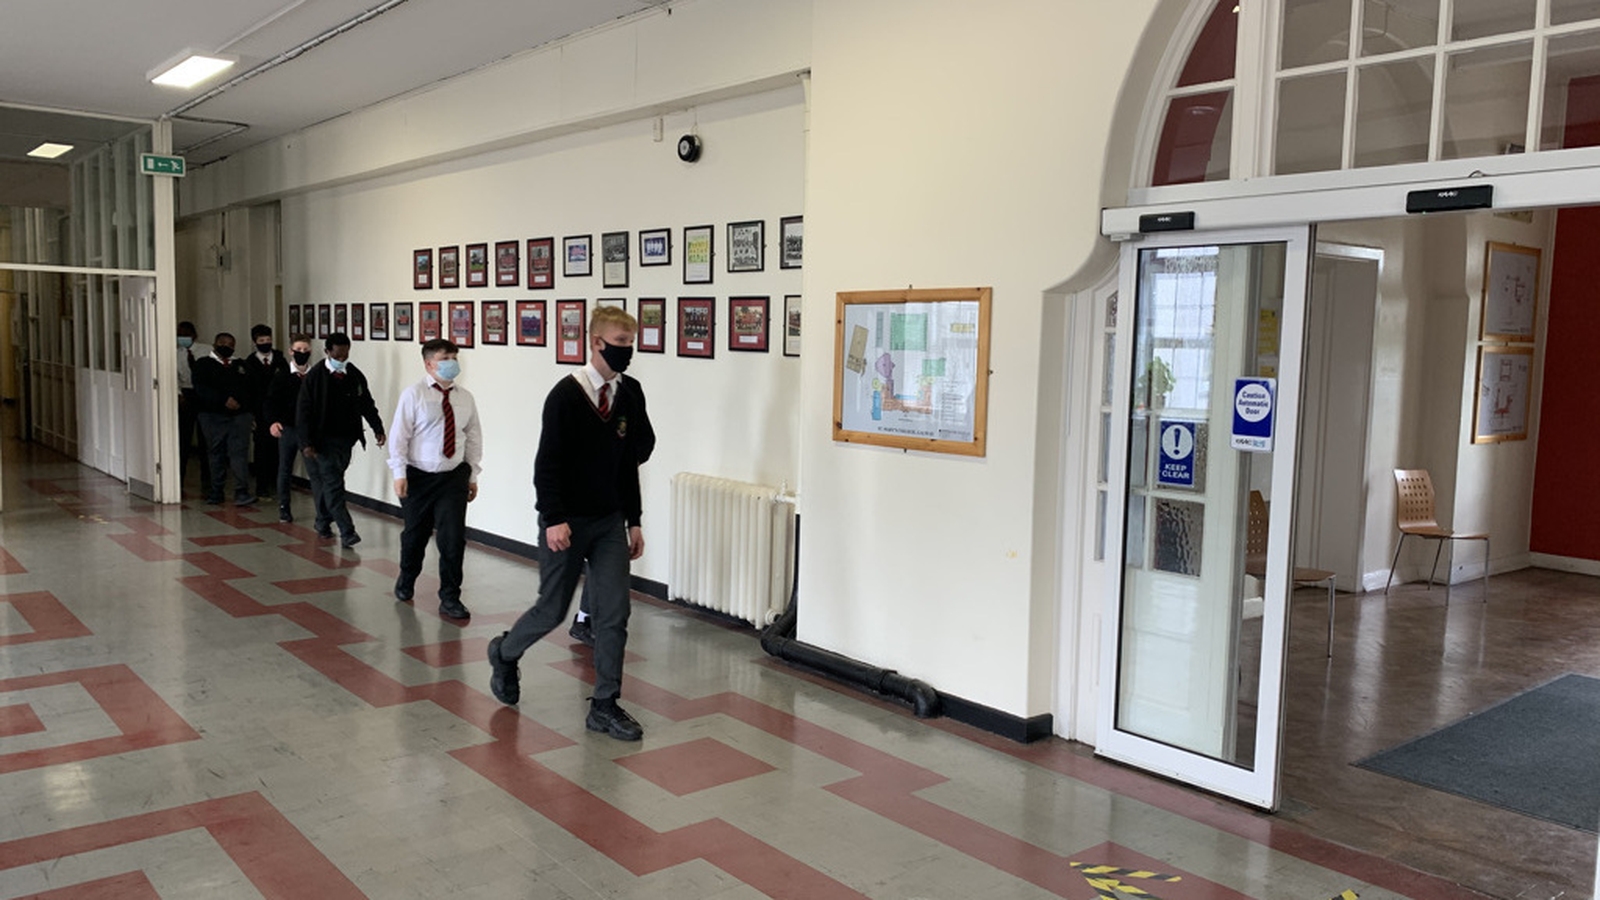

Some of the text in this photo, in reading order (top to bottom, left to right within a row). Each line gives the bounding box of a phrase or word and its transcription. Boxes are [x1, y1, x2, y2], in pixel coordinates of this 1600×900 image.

[1238, 399, 1269, 408] Automatic
[1165, 463, 1187, 471] KEEP
[1161, 470, 1190, 479] CLEAR
